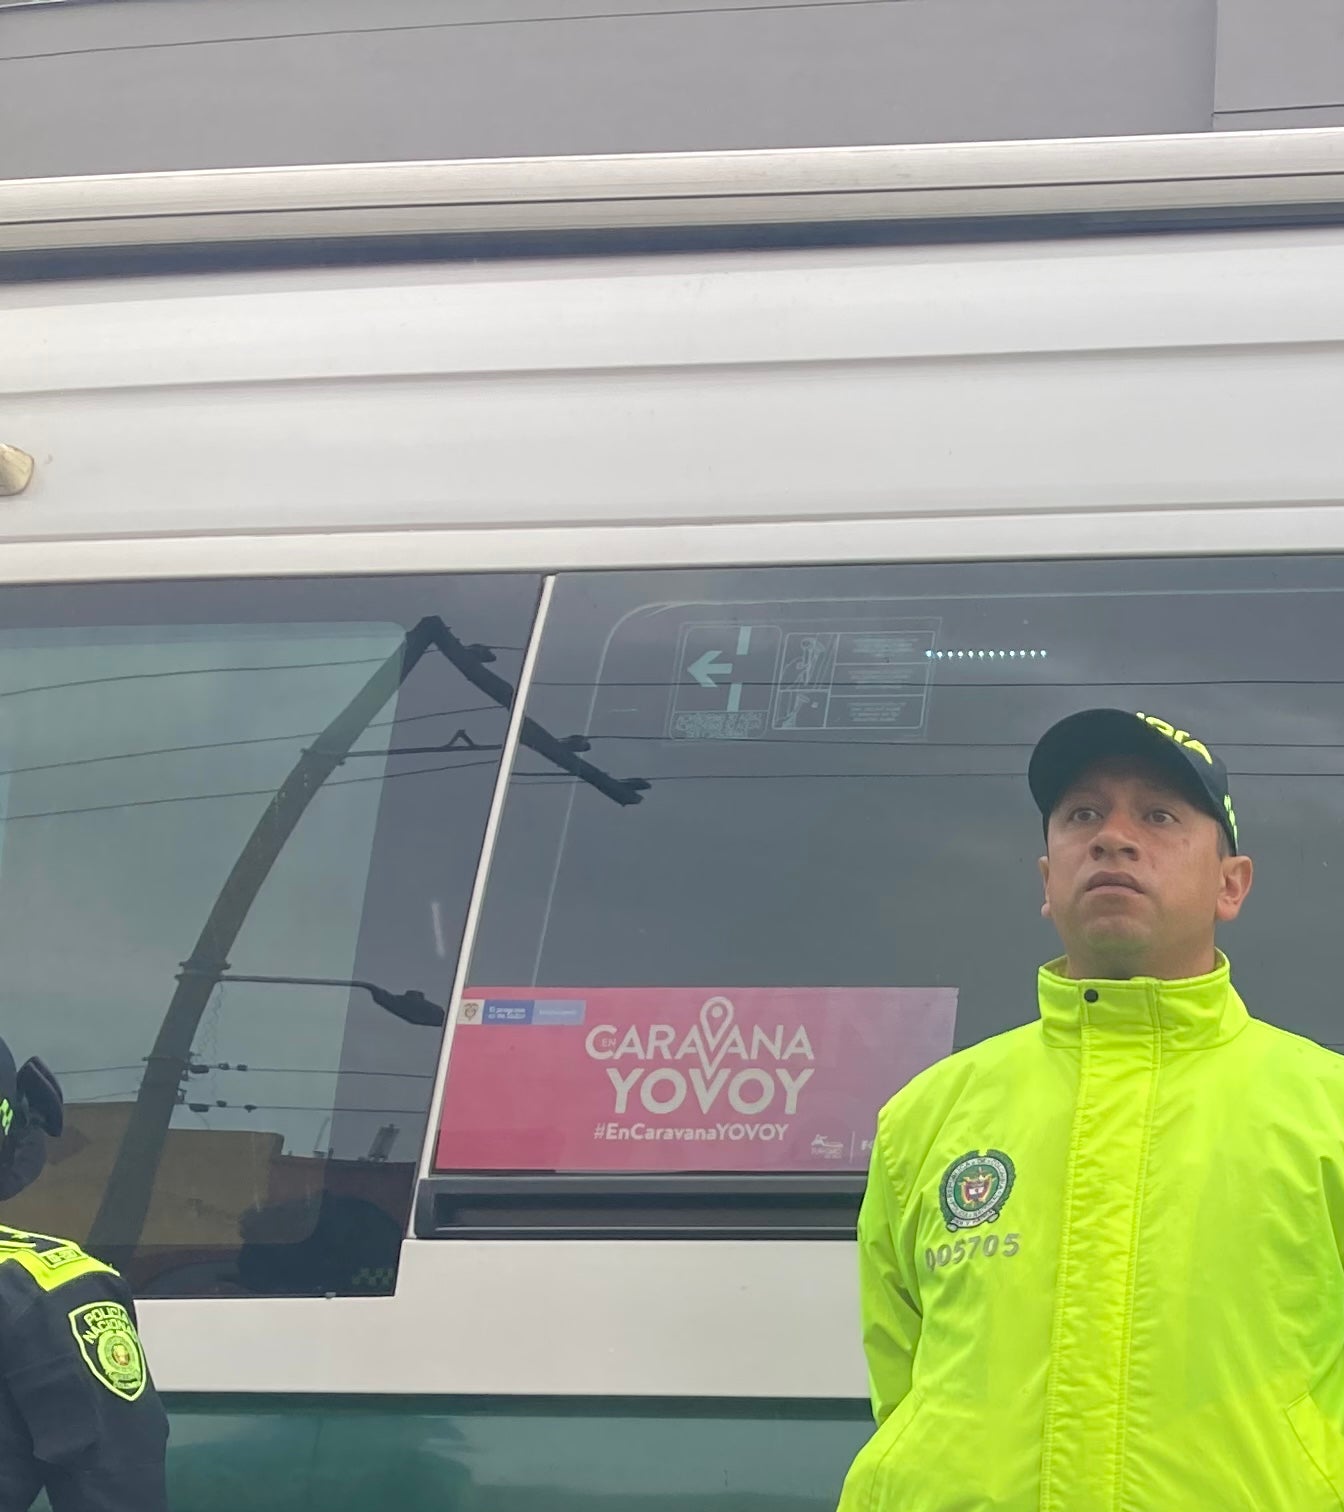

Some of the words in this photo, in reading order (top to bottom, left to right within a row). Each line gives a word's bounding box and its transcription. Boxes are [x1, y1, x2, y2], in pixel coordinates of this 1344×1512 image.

[585, 1022, 815, 1066] CARAVANA
[607, 1067, 815, 1115] YOVOY
[593, 1122, 789, 1142] #EnCaravanaYOVOY
